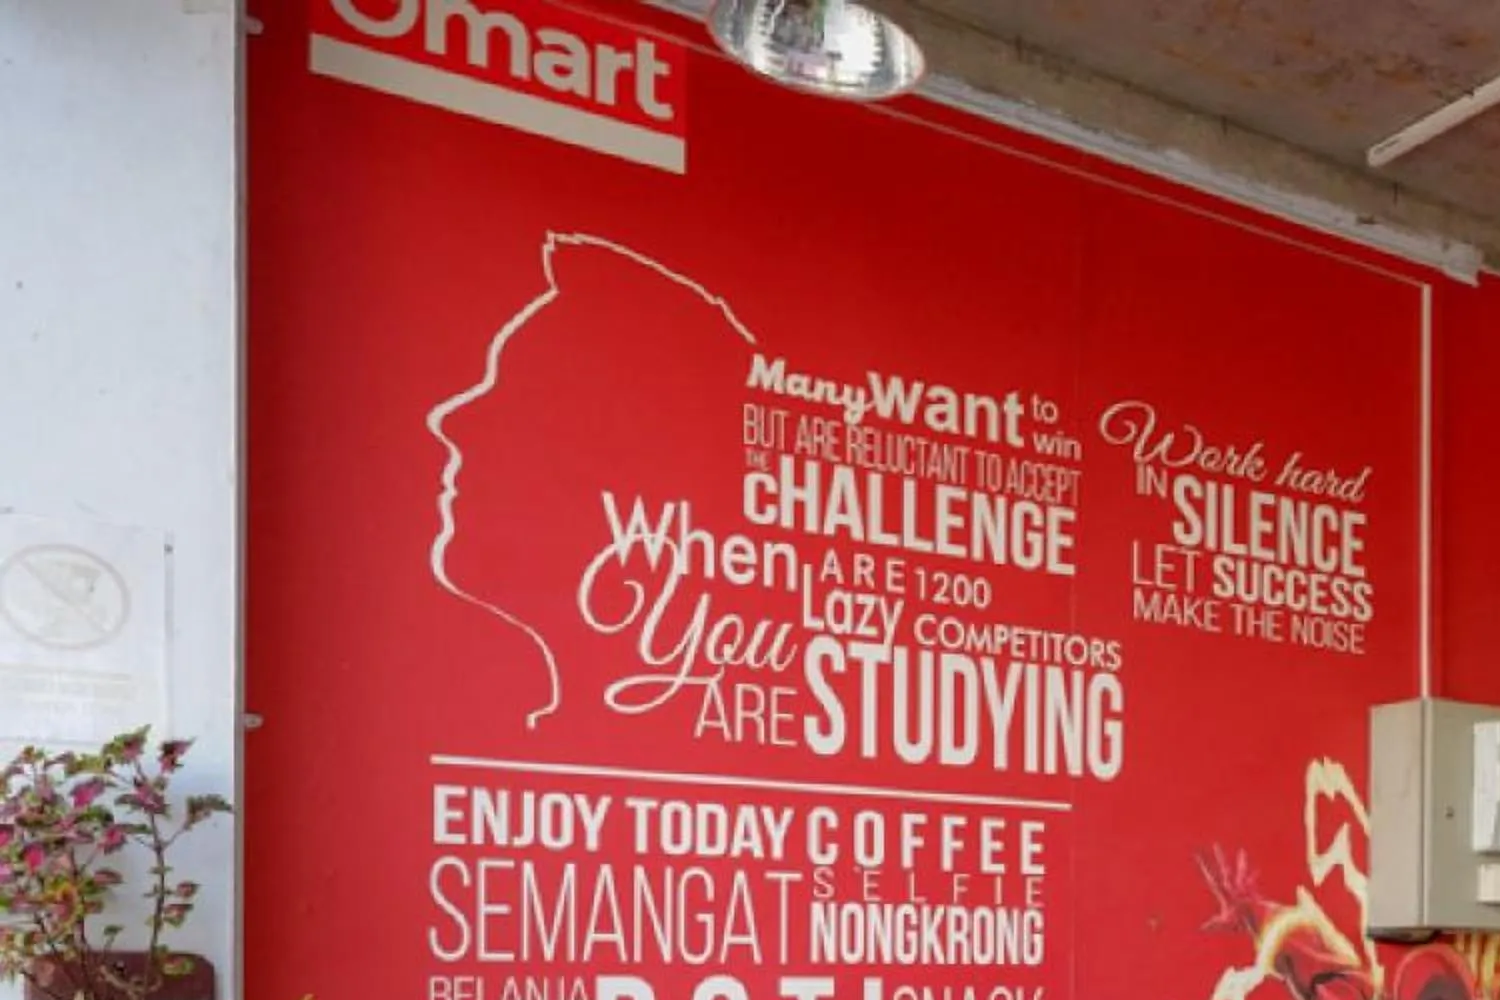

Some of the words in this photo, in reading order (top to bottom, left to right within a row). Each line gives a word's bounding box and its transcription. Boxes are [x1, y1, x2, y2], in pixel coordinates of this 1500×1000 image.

[747, 353, 872, 425] Many
[868, 371, 1024, 448] Want
[1032, 394, 1058, 424] to
[1033, 430, 1081, 461] win
[1099, 400, 1266, 482] Work
[1275, 451, 1372, 502] hard
[743, 403, 790, 450] BUT
[794, 414, 842, 462] ARE
[846, 425, 969, 484] RELUCTANT
[975, 449, 1001, 491] TO
[1004, 459, 1082, 507] ACCEPT
[602, 491, 798, 593] When
[820, 549, 906, 595] ARE
[915, 567, 992, 609] 1200
[1136, 462, 1168, 498] IN
[1172, 474, 1367, 579] SILENCE
[577, 534, 799, 714] You
[913, 614, 1122, 674] COMPETITORS
[1133, 540, 1200, 592] LET
[1213, 556, 1373, 622] SUCCESS
[1133, 588, 1223, 632] MAKE
[1231, 602, 1284, 641] THE
[1291, 616, 1366, 655] NOISE
[694, 675, 799, 748] ARE
[803, 634, 1124, 782] STUDYING
[431, 785, 612, 852] ENJOY
[625, 797, 793, 859] TODAY
[806, 806, 1046, 876] COFFEE
[428, 856, 804, 965] SEMANGAT
[812, 867, 1044, 909] SELFIE
[810, 902, 1045, 965] NONGKRONG
